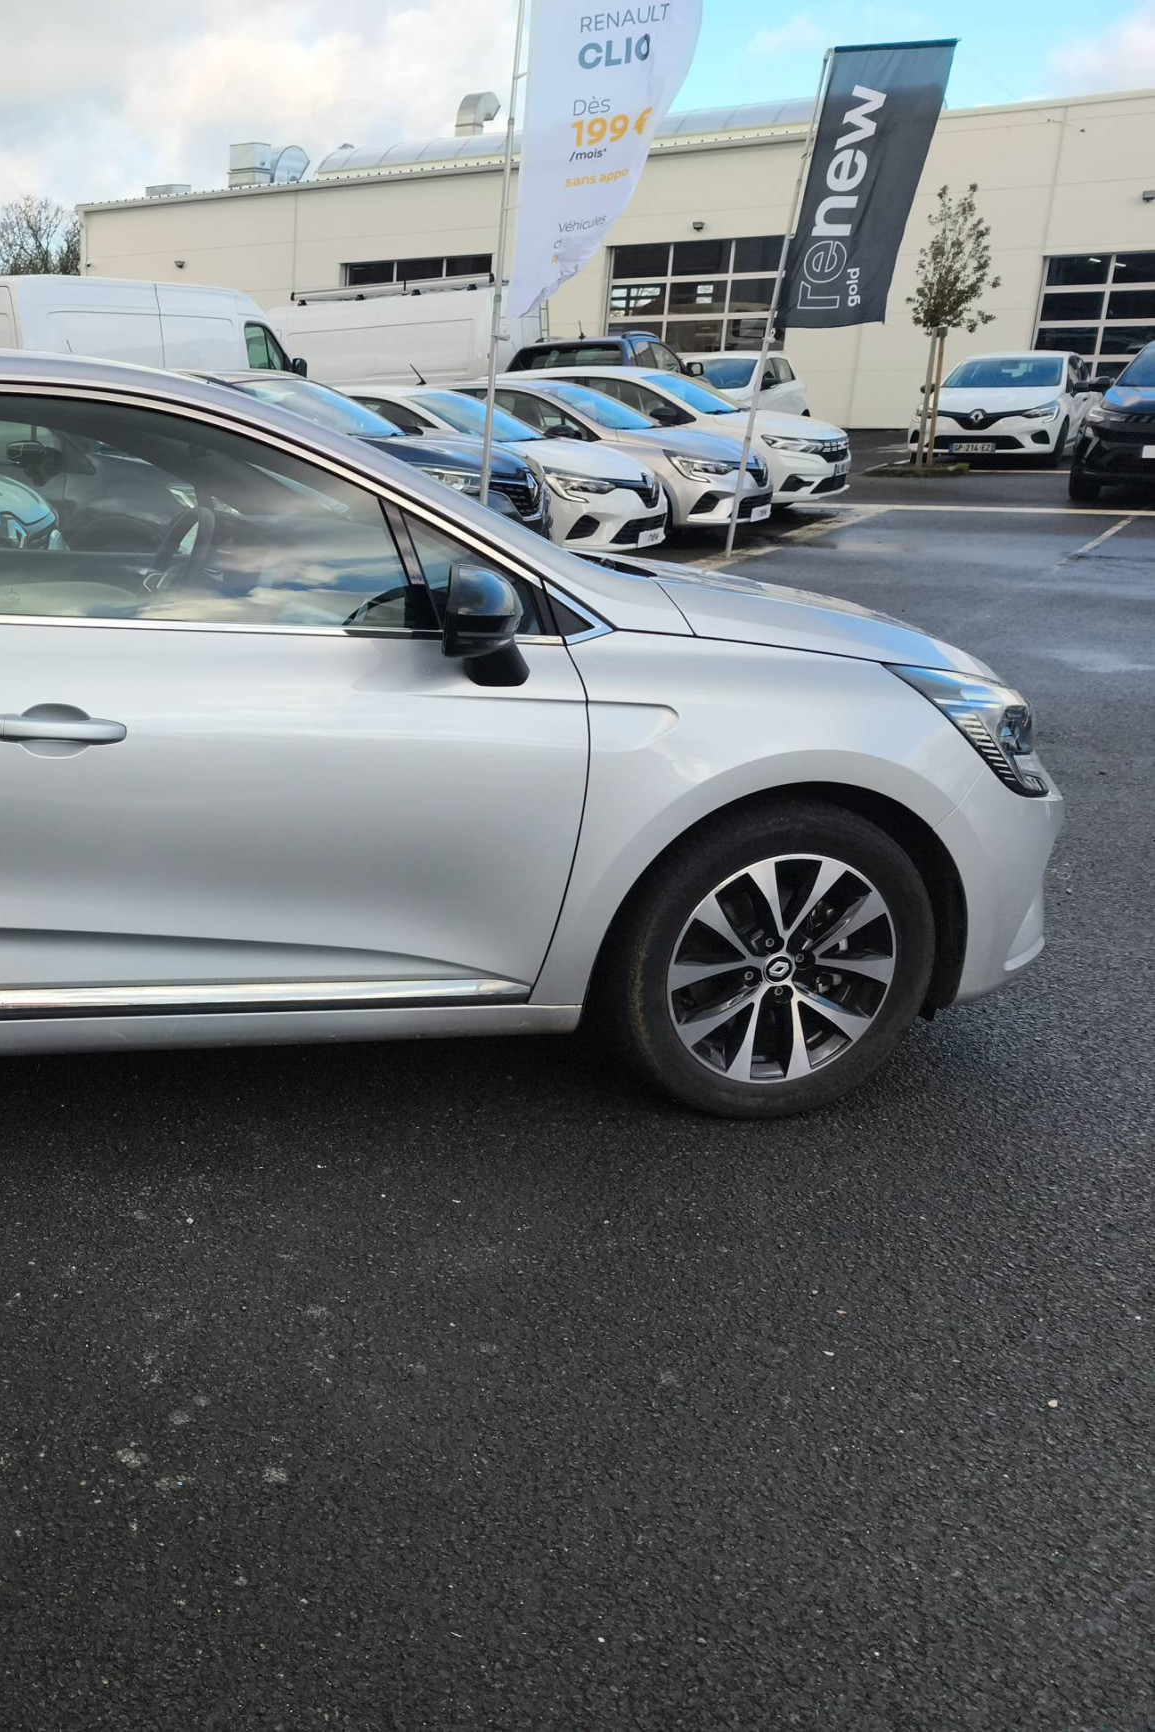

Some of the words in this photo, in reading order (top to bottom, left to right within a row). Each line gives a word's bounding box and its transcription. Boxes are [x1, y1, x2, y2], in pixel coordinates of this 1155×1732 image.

[579, 2, 671, 34] RENAULT
[578, 33, 651, 70] CLIO
[572, 96, 612, 117] Dès
[571, 113, 630, 148] 199
[633, 106, 654, 136] €
[564, 175, 597, 188] sans
[797, 84, 887, 310] renew
[558, 215, 607, 233] Véhicules
[846, 267, 860, 307] gold
